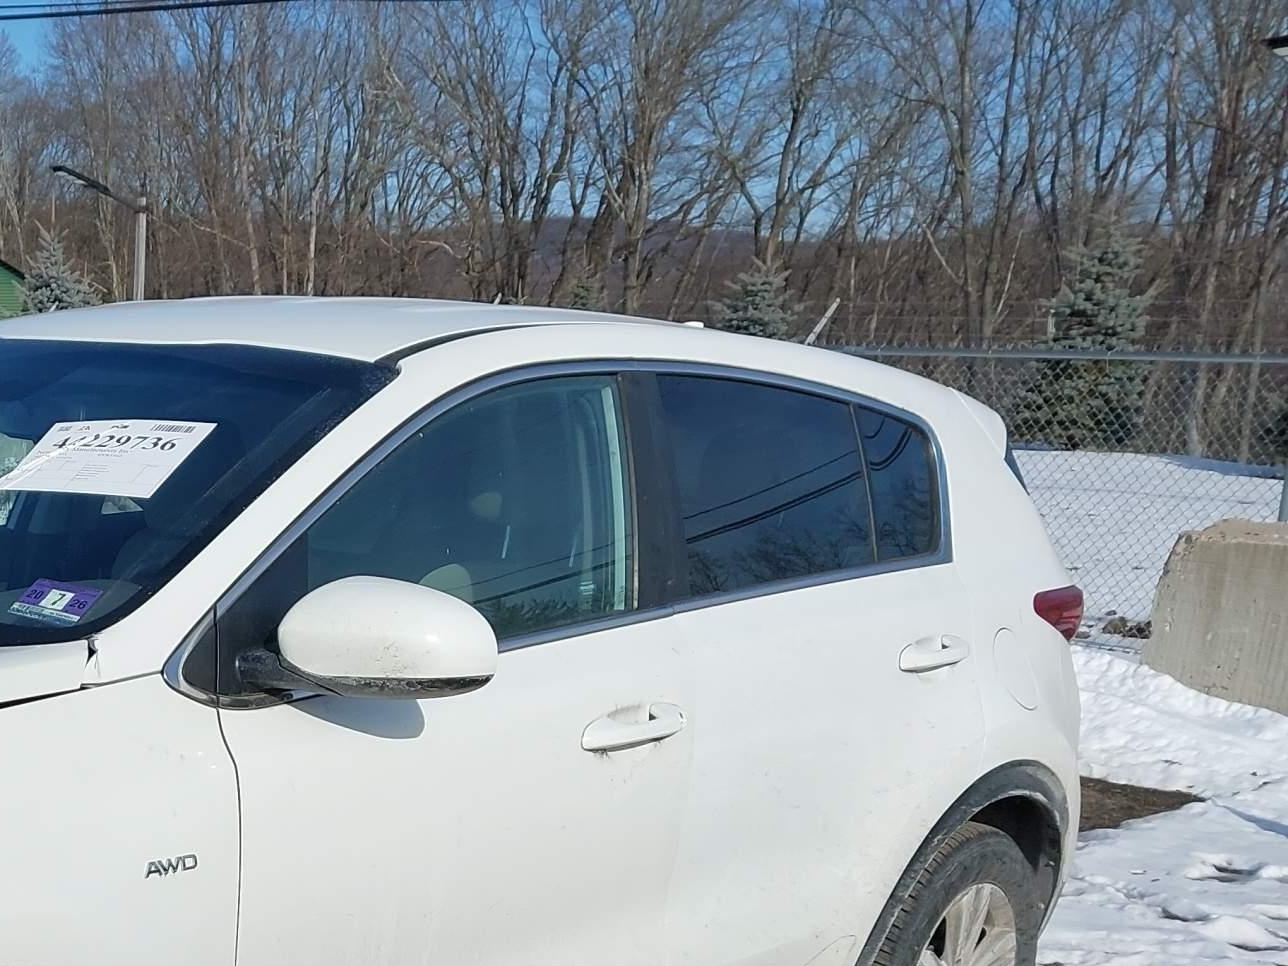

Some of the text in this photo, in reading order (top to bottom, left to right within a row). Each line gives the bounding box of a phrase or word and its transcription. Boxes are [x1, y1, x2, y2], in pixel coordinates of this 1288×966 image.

[51, 593, 66, 606] 7
[70, 599, 88, 609] 26
[144, 854, 198, 878] AWD
